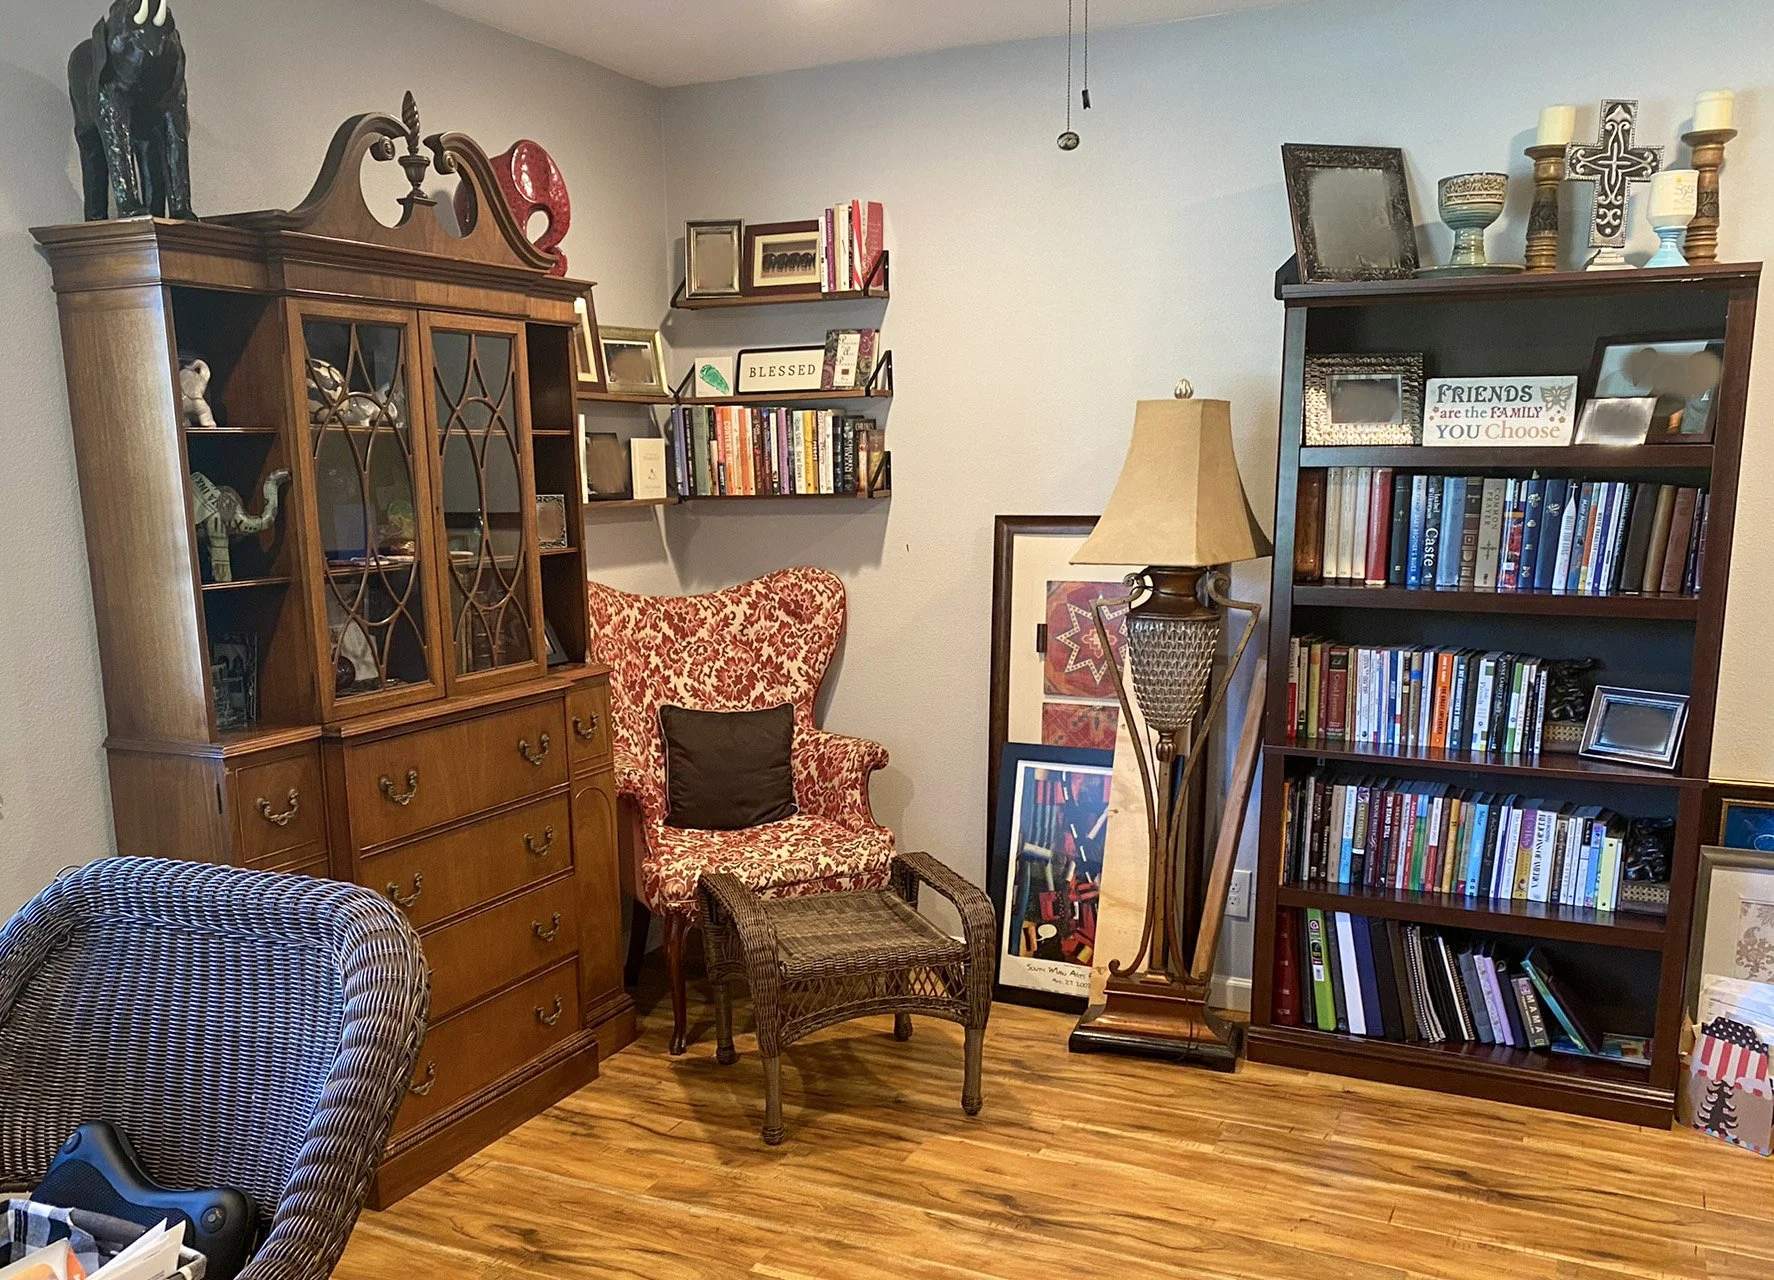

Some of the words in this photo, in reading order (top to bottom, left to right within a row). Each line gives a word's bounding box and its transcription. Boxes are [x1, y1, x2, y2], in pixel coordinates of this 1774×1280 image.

[749, 364, 816, 378] BLESSED
[1436, 384, 1533, 402] FRIENDS
[1440, 410, 1462, 418] are
[1465, 406, 1487, 418] the
[1490, 406, 1542, 418] FAMILY
[1436, 424, 1482, 439] YOU
[1484, 420, 1560, 439] Choose
[1484, 491, 1493, 526] PRAYER
[1490, 487, 1501, 529] COMMON
[1423, 527, 1438, 567] Caste
[1527, 994, 1543, 1033] MAMA
